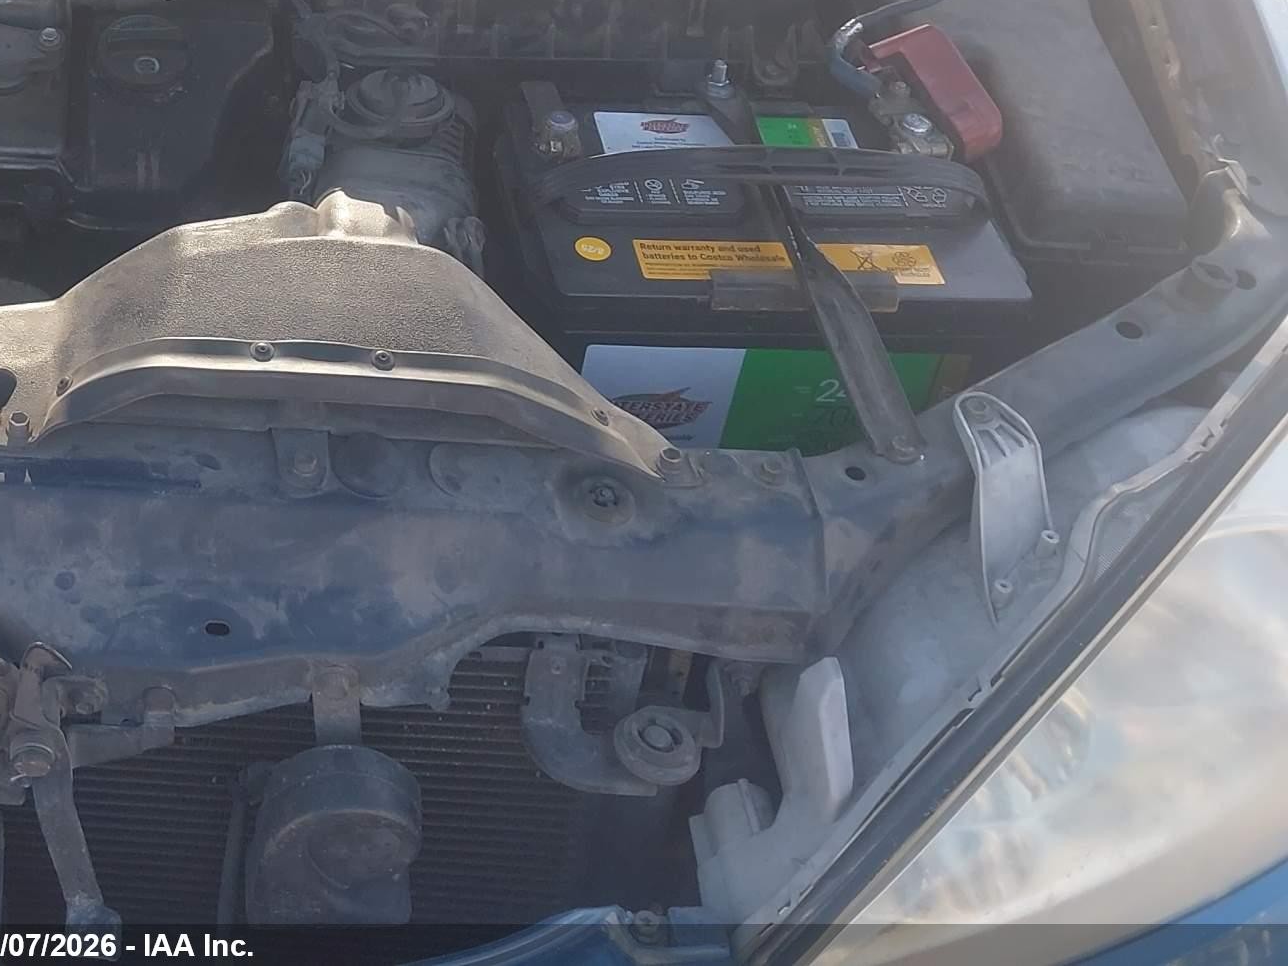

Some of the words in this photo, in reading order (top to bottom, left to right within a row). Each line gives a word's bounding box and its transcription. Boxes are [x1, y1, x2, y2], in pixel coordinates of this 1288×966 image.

[639, 242, 672, 252] Return
[672, 243, 715, 253] warranty
[718, 244, 737, 252] and
[738, 244, 761, 253] used
[641, 251, 686, 261] batteries
[687, 252, 698, 261] to
[699, 253, 733, 262] Costco
[734, 253, 787, 263] Wholesale
[614, 401, 708, 412] TERSTATE
